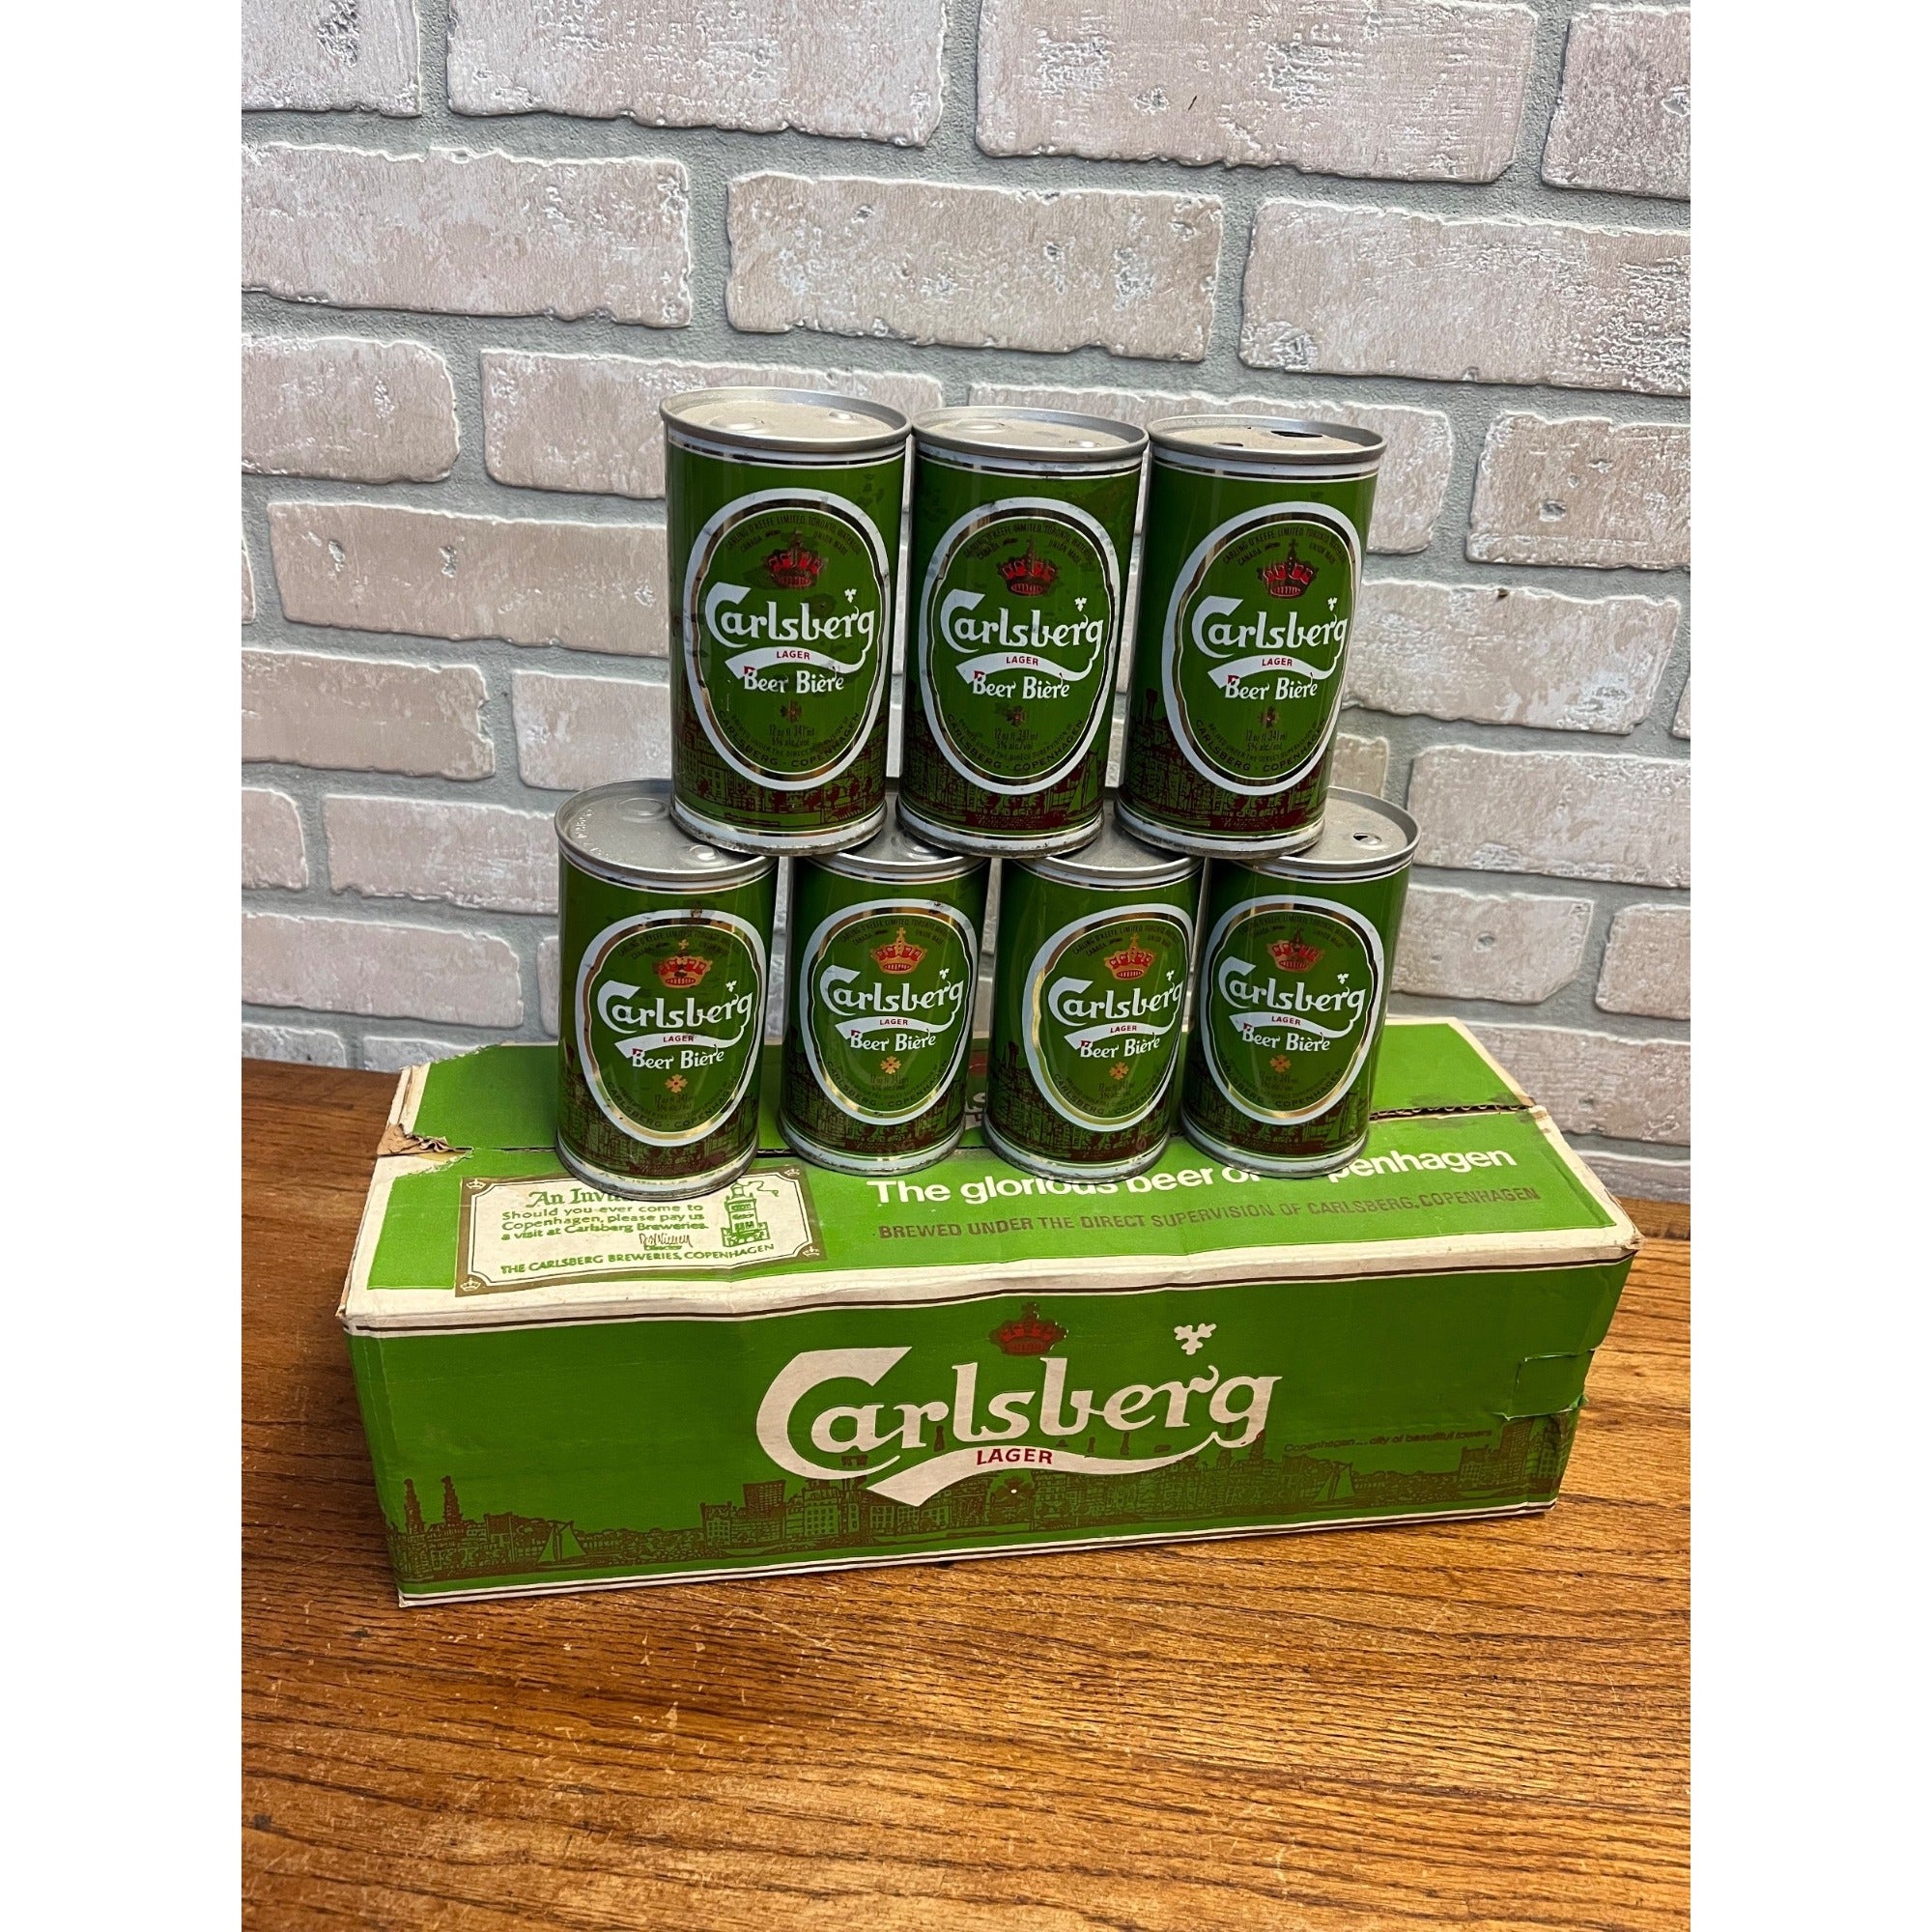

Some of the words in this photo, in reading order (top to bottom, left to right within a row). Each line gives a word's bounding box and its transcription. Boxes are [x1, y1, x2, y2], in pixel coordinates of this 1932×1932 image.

[777, 514, 806, 525] LIMITED
[1277, 526, 1305, 537] LIMITED
[1237, 547, 1262, 566] CANADA
[704, 582, 875, 650] Carlsberg
[940, 588, 1104, 653] Carlsberg
[1191, 595, 1349, 659] Carlsberg
[776, 649, 810, 661] LAGER
[1006, 655, 1038, 667] LAGER
[1262, 657, 1293, 668] LAGER
[744, 667, 788, 695] Beer
[796, 668, 844, 694] Bière
[973, 673, 1016, 699] Beer
[1022, 675, 1070, 699] Bière
[1225, 676, 1269, 700] Beer
[1275, 678, 1318, 701] Bière
[719, 709, 779, 766] CARLSBERG
[791, 712, 860, 767] COPENHAGEN
[948, 713, 1002, 769] CARLSBERG
[1013, 720, 1083, 771] COPENHAGEN
[1196, 719, 1250, 771] CARLSBERG
[1263, 718, 1325, 772] COPENHAGEN
[819, 963, 964, 1017] Carlsberg
[1217, 955, 1366, 1017] Carlsberg
[597, 980, 753, 1035] Carlsberg
[1048, 975, 1184, 1027] Carlsberg
[879, 1018, 908, 1027] LAGER
[1110, 1025, 1137, 1034] LAGER
[1271, 1016, 1301, 1027] LAGER
[663, 1035, 695, 1044] LAGER
[849, 1032, 890, 1052] Beer
[895, 1032, 936, 1052] Bière
[1080, 1041, 1120, 1059] Beer
[1123, 1036, 1161, 1058] Bière
[1242, 1026, 1281, 1050] Beer
[1286, 1032, 1330, 1052] Bière
[631, 1049, 674, 1070] Beer
[680, 1046, 724, 1070] Bière
[1055, 1073, 1105, 1115] CARLSBERG
[1275, 1067, 1342, 1107] COPENHAGEN
[608, 1082, 663, 1128] CARLSBERG
[526, 1190, 565, 1208] An
[867, 1179, 952, 1203] The
[960, 1176, 1119, 1206] glorious
[1125, 1167, 1213, 1193] beer
[501, 1208, 558, 1221] Should
[564, 1207, 592, 1219] you
[501, 1216, 605, 1232] Copenhagen,
[607, 1214, 655, 1224] please
[660, 1213, 685, 1223] pay
[878, 1223, 962, 1239] BREWED
[966, 1217, 1033, 1236] UNDER
[1037, 1216, 1075, 1230] THE
[1080, 1214, 1145, 1229] DIRECT
[1151, 1204, 1275, 1228] SUPERVISION
[1280, 1203, 1301, 1216] OF
[514, 1230, 543, 1238] visit
[564, 1223, 634, 1234] Carlsberg
[638, 1222, 709, 1231] Breweries.
[501, 1264, 526, 1274] THE
[528, 1255, 603, 1270] CARLSBERG
[608, 1252, 682, 1263] BREWERIES,
[684, 1243, 775, 1260] COPENHAGEN
[755, 1345, 1283, 1480] Carlsberg
[1392, 1433, 1405, 1443] of
[1406, 1430, 1455, 1443] beautiful
[976, 1447, 1054, 1466] LAGER
